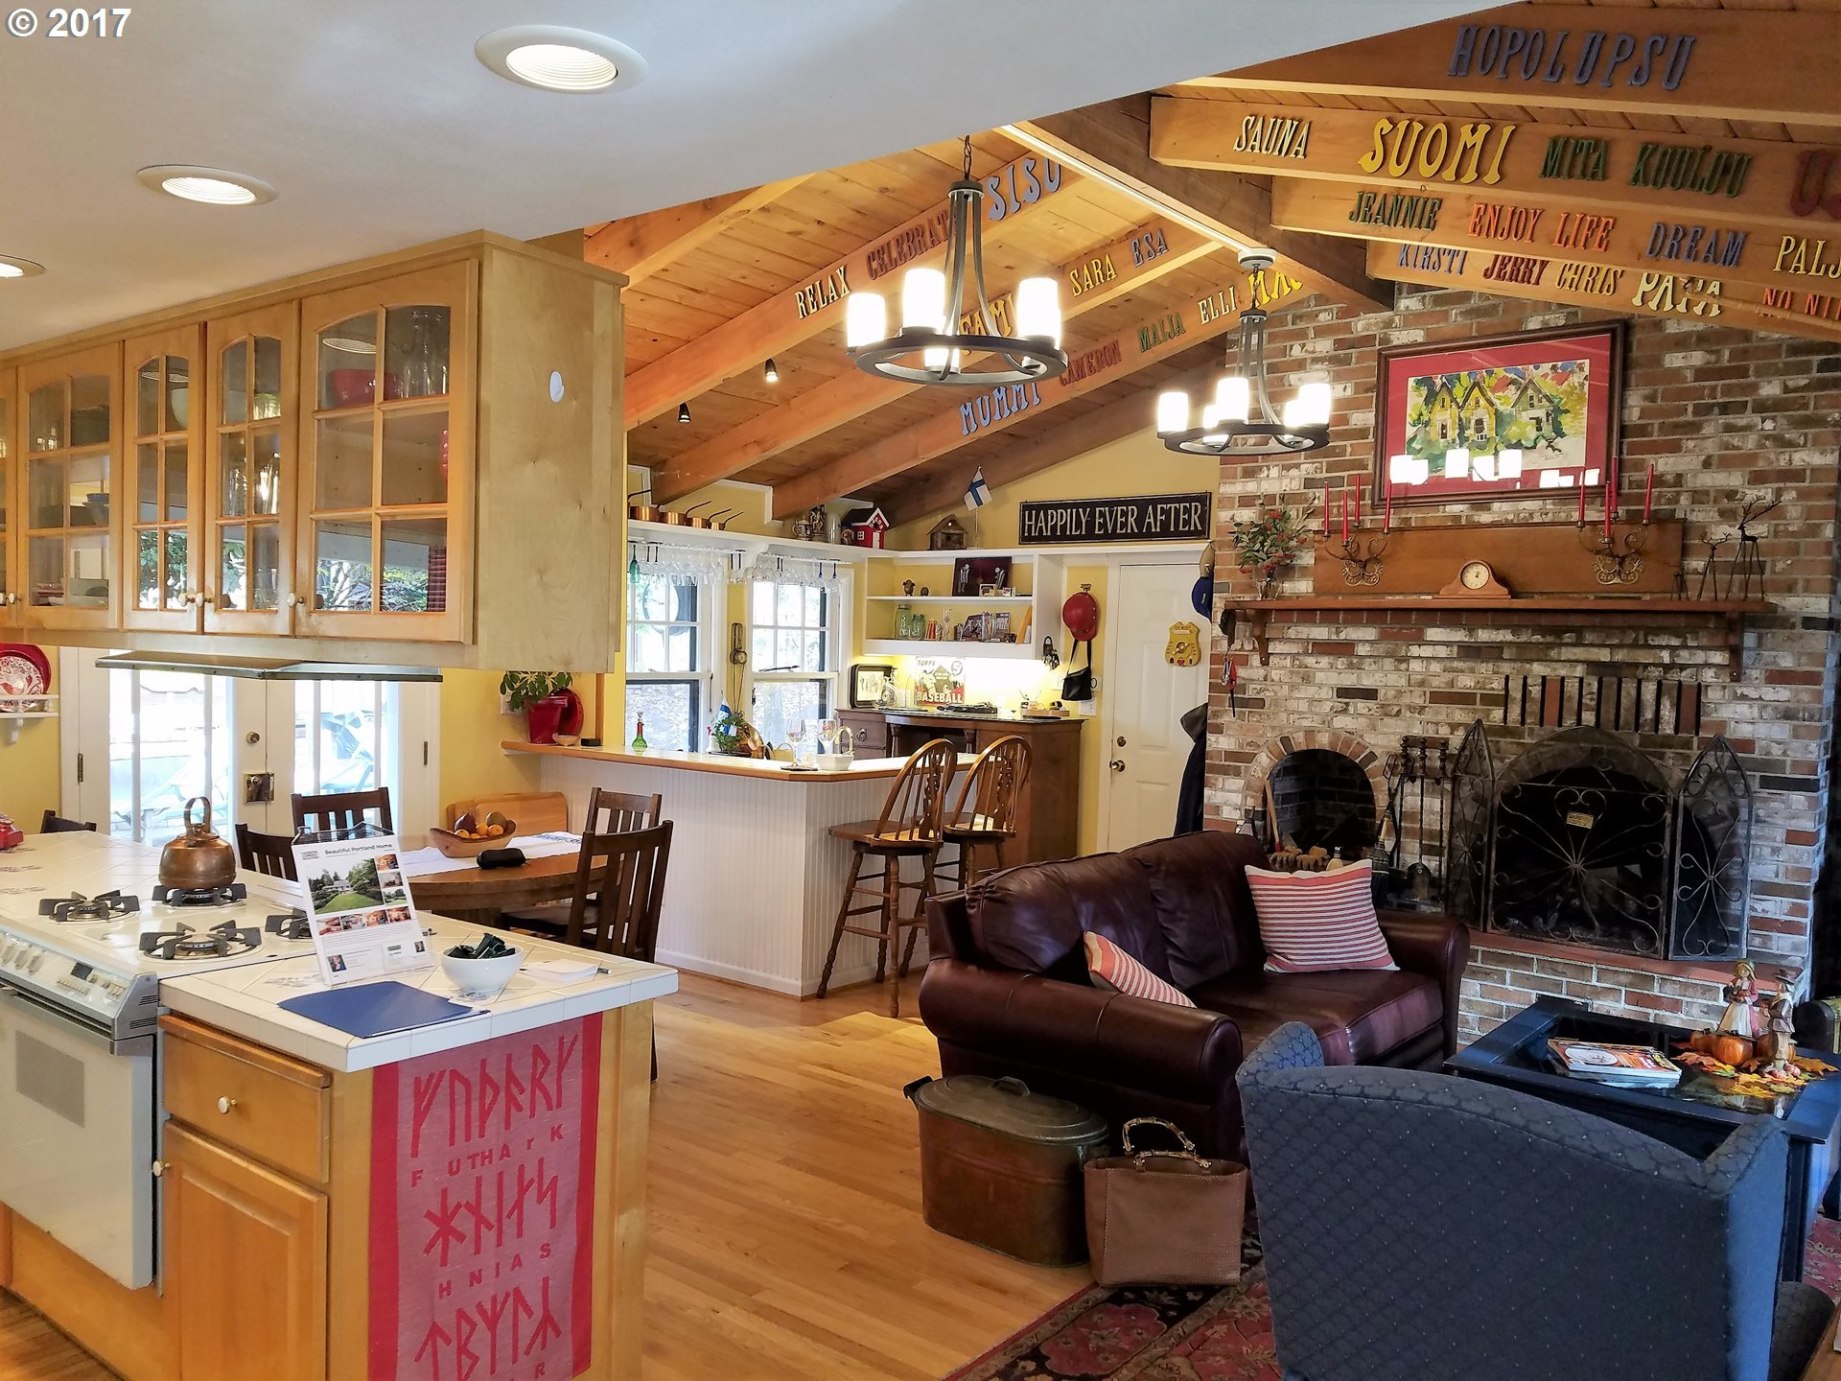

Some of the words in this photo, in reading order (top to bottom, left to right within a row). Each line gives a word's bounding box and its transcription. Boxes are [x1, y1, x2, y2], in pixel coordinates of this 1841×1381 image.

[1447, 25, 1697, 91] HOPOLUPSU
[1232, 114, 1312, 160] SAUNA
[1358, 117, 1517, 185] SUOMI
[794, 264, 850, 320] RELAX
[865, 208, 958, 281] CELEBRAT
[987, 158, 1062, 221] SISU
[1069, 253, 1118, 298] SARA
[1130, 228, 1171, 269] ESA
[1348, 190, 1442, 231] JEANNIE
[1467, 202, 1544, 244] ENJOY
[1552, 211, 1616, 252] LIFE
[1645, 222, 1748, 268] DREAM
[1397, 243, 1468, 276] KIRSTI
[1482, 253, 1551, 287] JERRY
[1555, 262, 1625, 297] CHRIS
[1137, 312, 1187, 353] MAIJA
[1198, 284, 1238, 326] ELLI
[1023, 508, 1090, 537] HAPPILY
[1094, 505, 1139, 535] EVER
[1143, 502, 1203, 533] AFTER
[916, 691, 965, 704] BASEBALL
